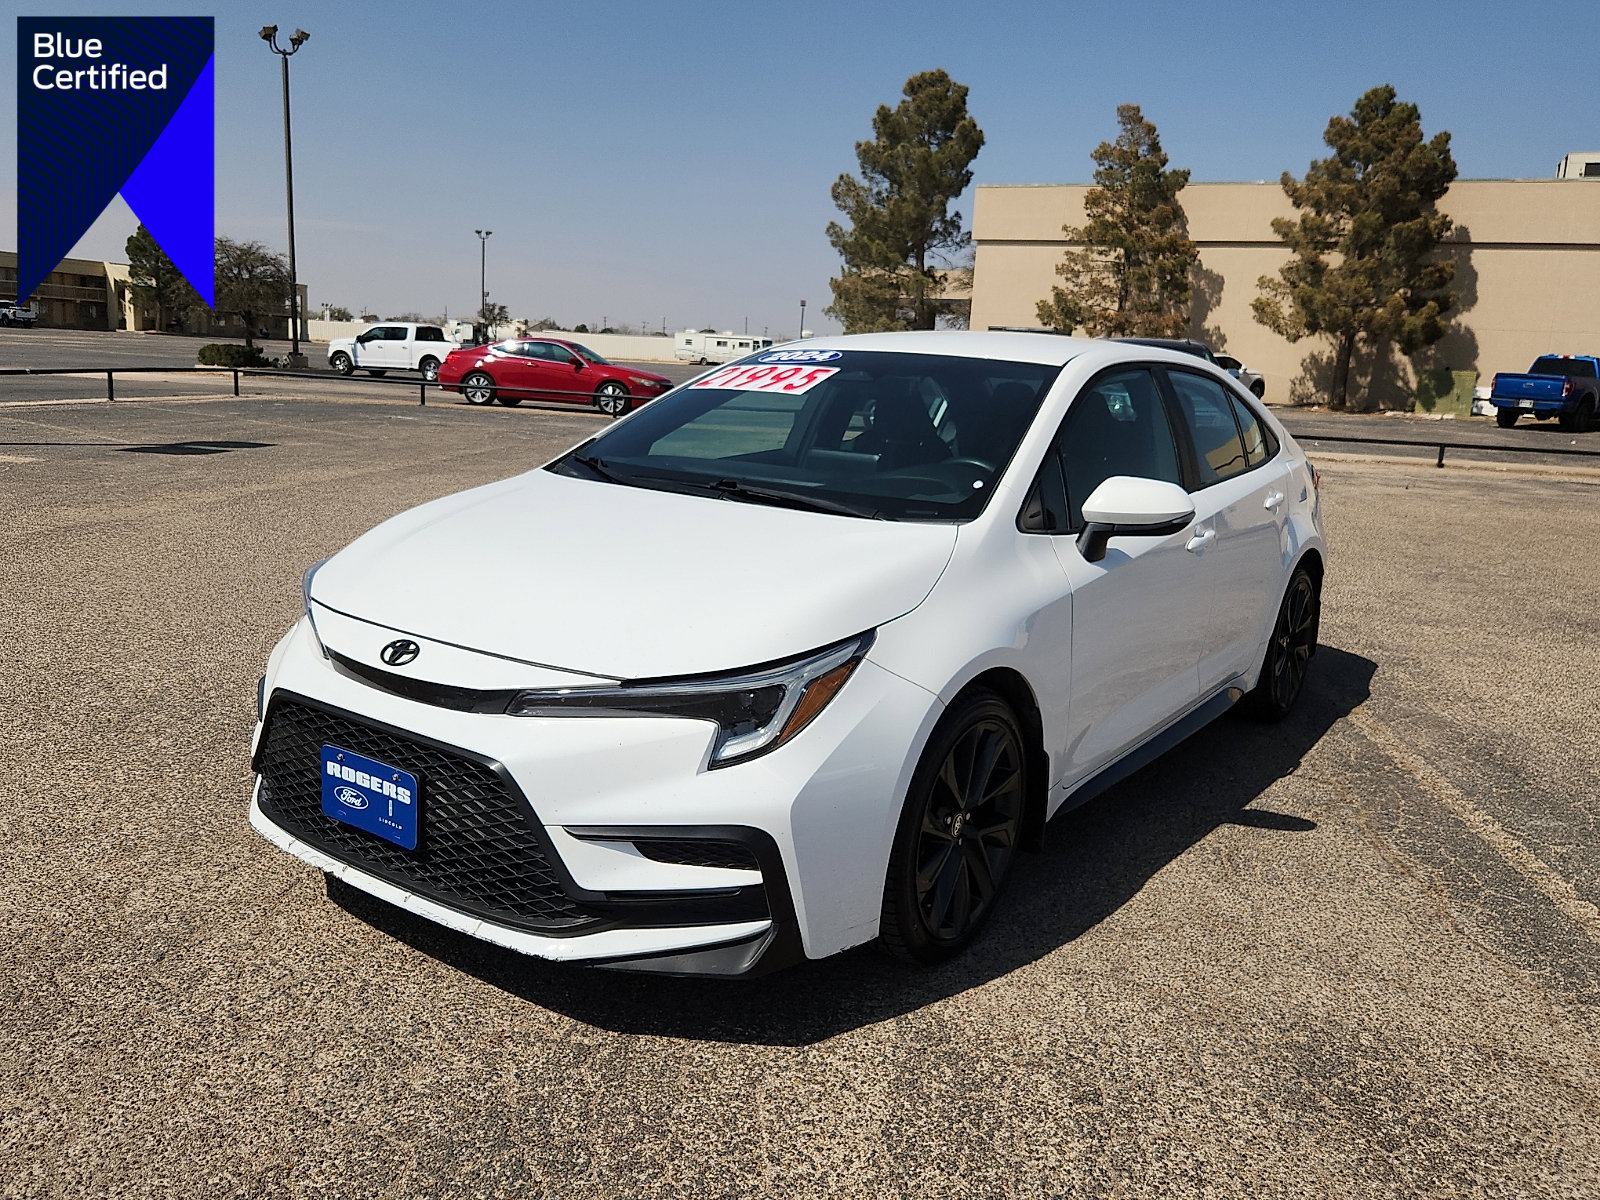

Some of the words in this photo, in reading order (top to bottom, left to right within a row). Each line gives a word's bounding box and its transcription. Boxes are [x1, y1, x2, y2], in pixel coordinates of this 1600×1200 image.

[764, 350, 832, 362] 2024
[694, 366, 835, 391] 21995
[326, 760, 411, 805] ROGERS
[340, 788, 362, 807] Ford
[378, 816, 403, 830] LINCOLN
